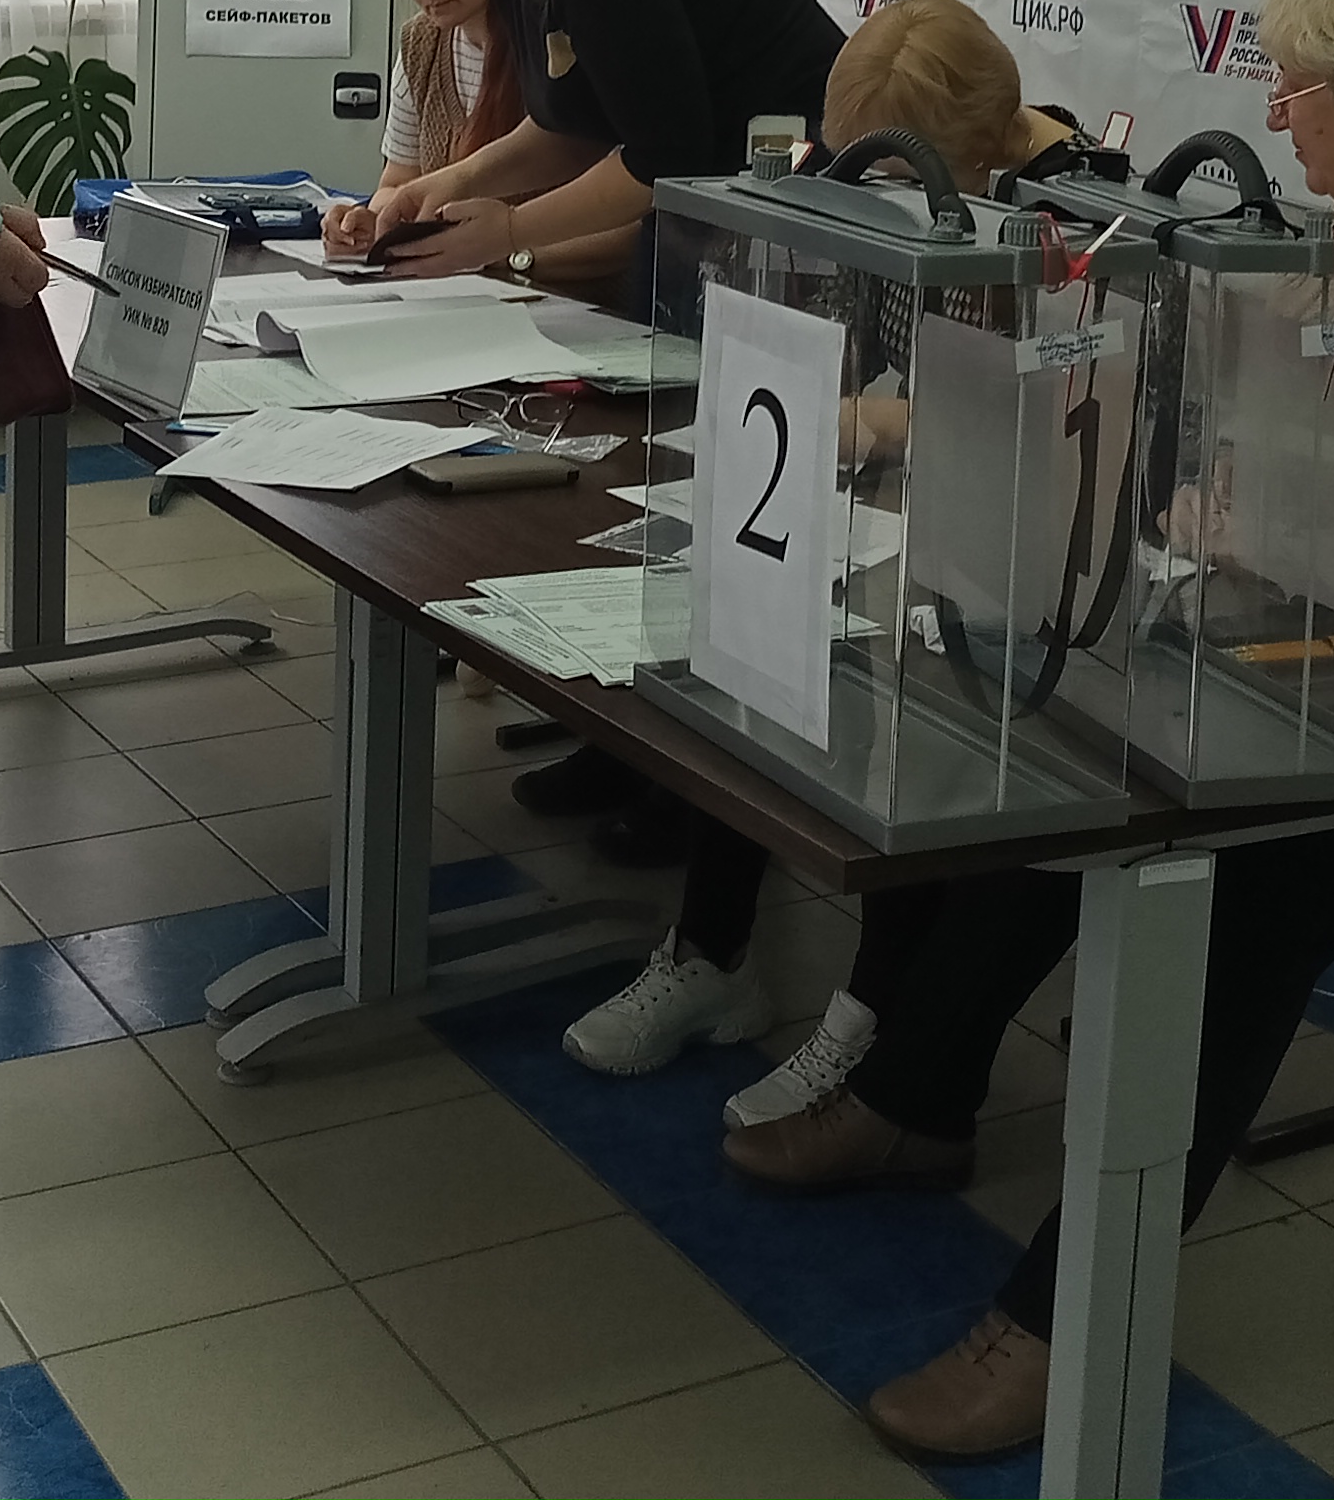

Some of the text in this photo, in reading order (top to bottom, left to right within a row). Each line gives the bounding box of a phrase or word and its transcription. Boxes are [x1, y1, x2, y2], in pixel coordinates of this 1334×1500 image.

[205, 8, 331, 25] СЕЙФ-ПАКЕТОВ
[106, 263, 203, 311] СПИСОК ИЗБИРАТЕЛЕЙ
[123, 305, 142, 326] УИК
[152, 316, 169, 336] 820
[735, 387, 791, 563] 2
